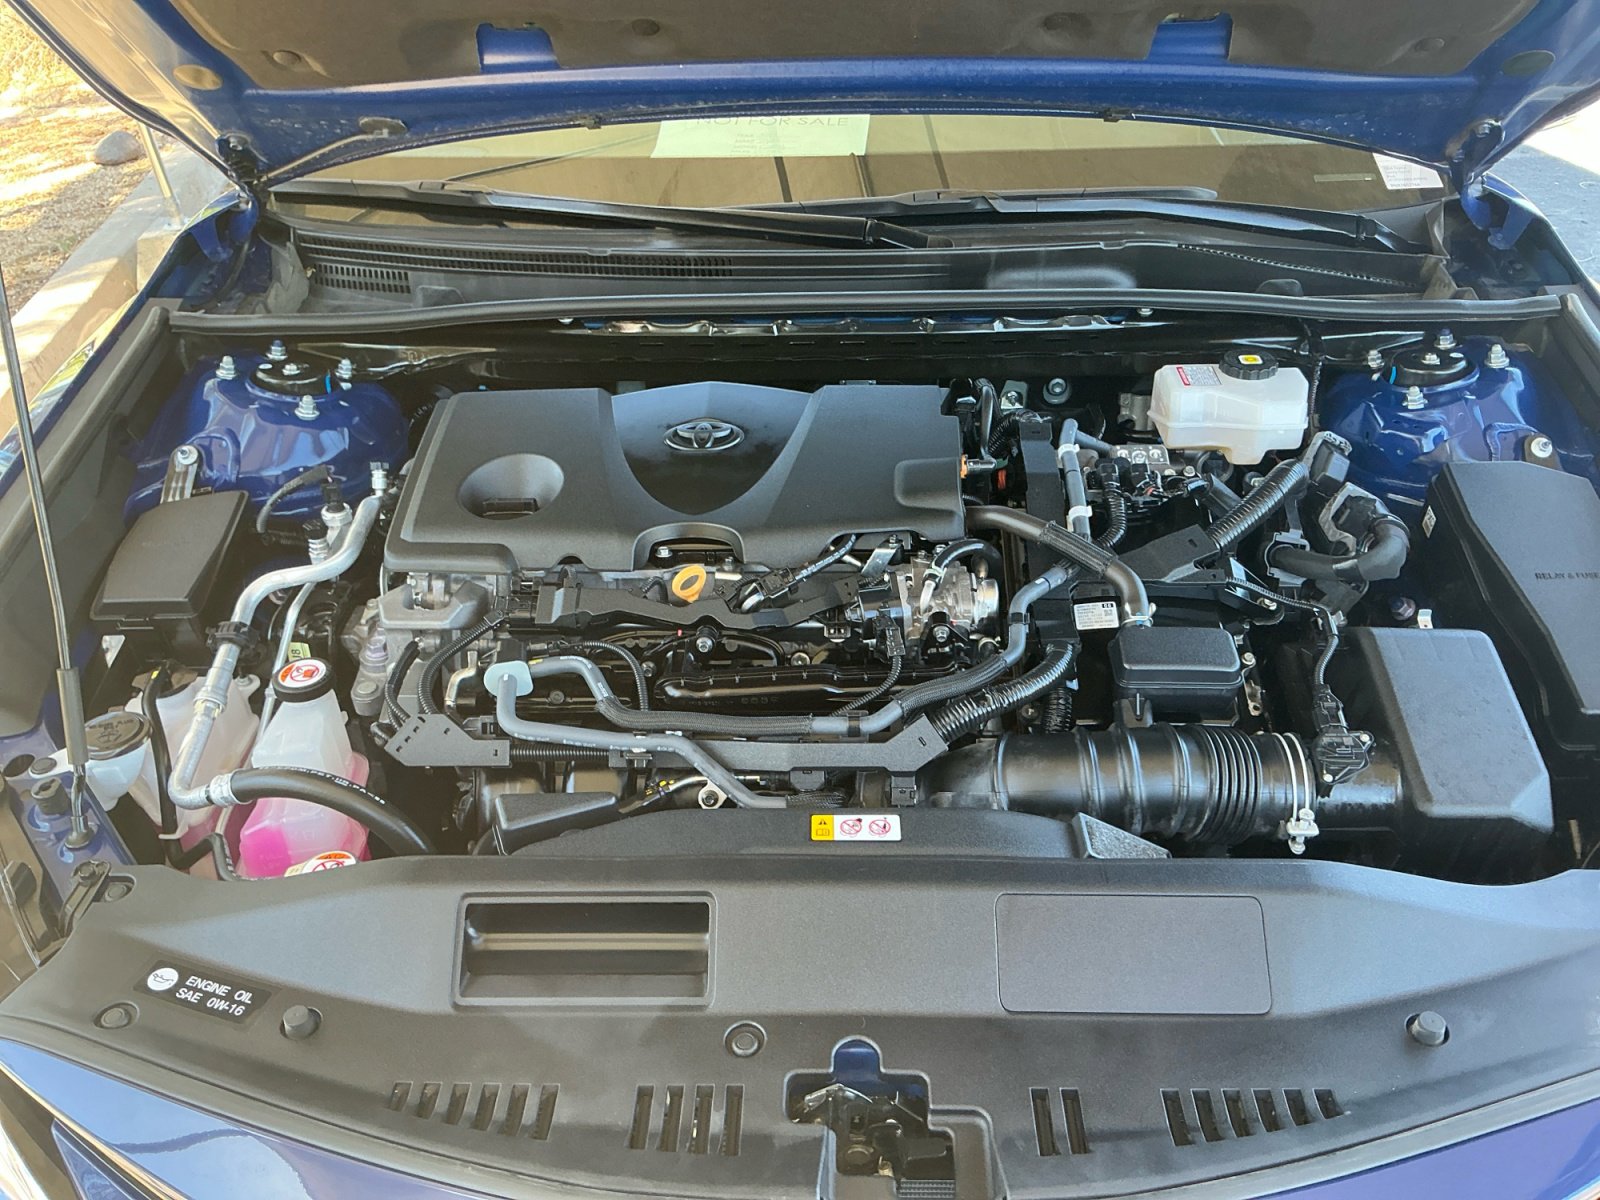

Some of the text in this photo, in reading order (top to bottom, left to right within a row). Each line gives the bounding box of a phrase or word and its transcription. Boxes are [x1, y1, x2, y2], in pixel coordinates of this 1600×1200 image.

[749, 116, 790, 126] FOR
[797, 117, 849, 127] SALE
[175, 988, 245, 1016] SAE 0W-16
[185, 976, 253, 1004] ENGINE OIL
